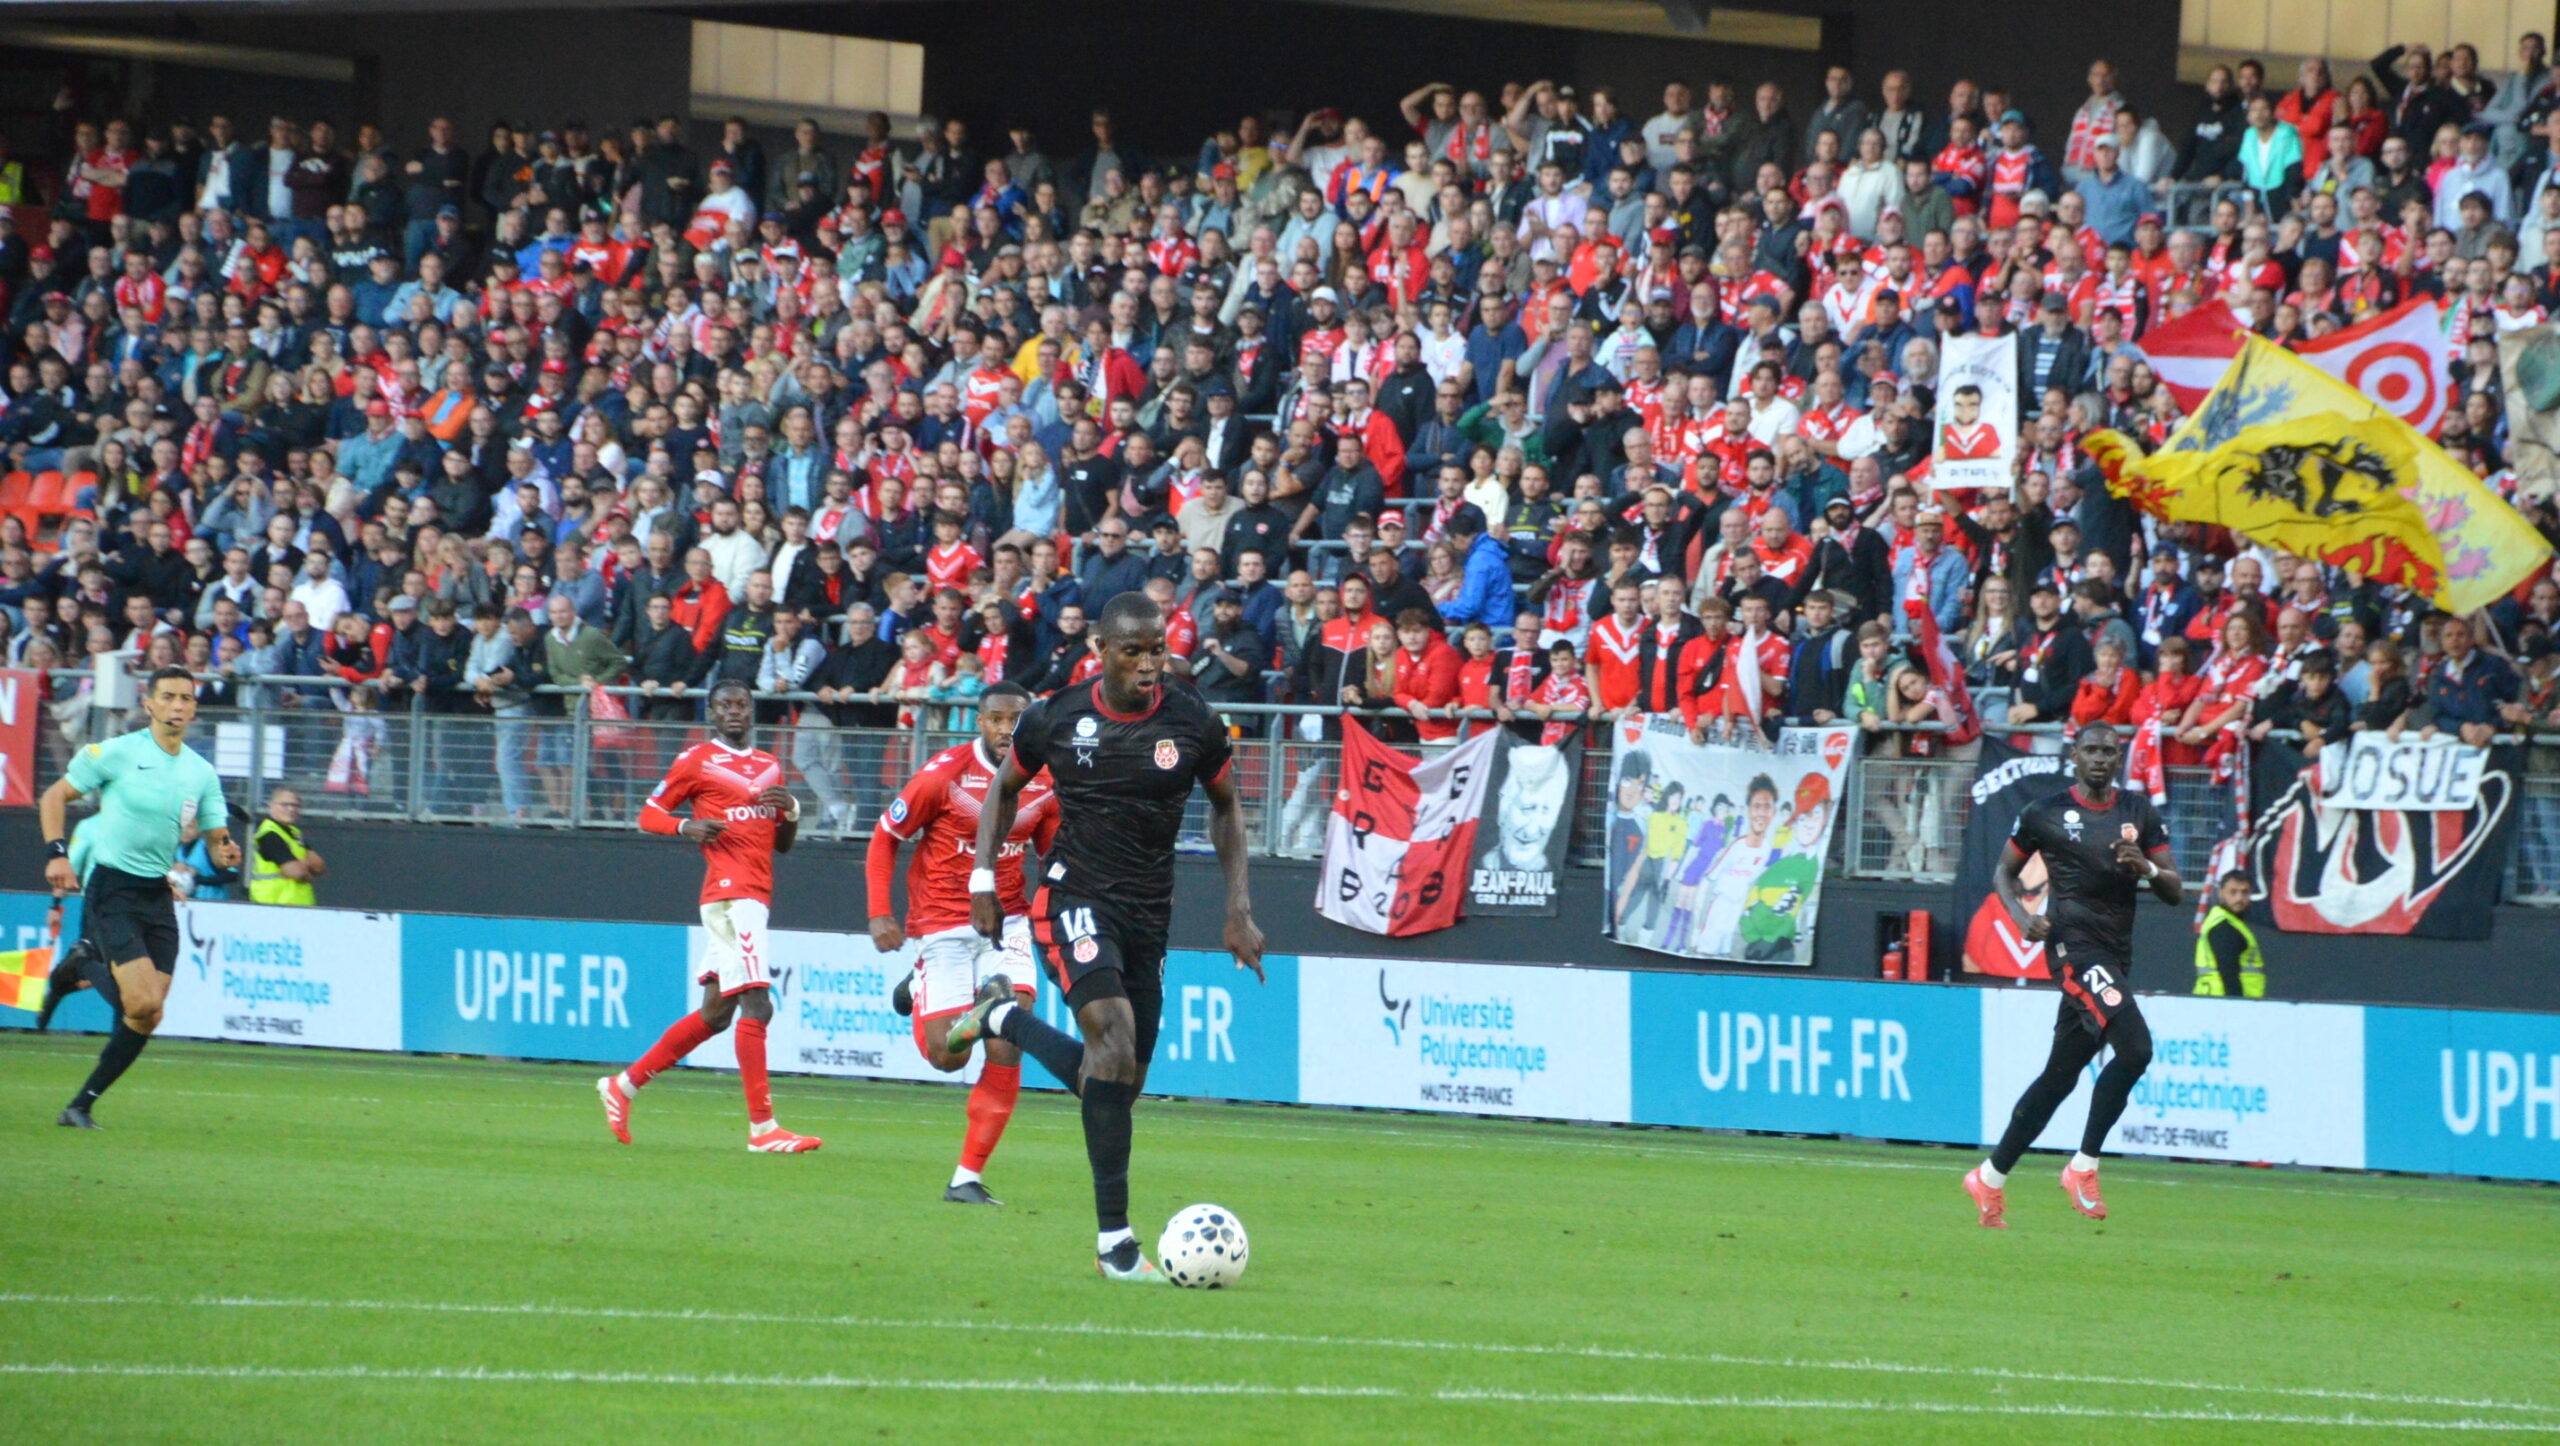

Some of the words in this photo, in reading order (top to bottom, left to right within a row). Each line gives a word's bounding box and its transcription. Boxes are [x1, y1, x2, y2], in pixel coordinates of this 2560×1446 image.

[1971, 756, 2060, 806] SECTION
[2322, 746, 2482, 803] JOSUE
[1469, 869, 1556, 895] JEAN-PAUL
[1060, 907, 1097, 943] 14
[223, 934, 304, 967] Université
[223, 969, 331, 1010] Polytechnique
[455, 949, 631, 1029] UPHF.FR
[800, 962, 885, 998] Université
[2082, 965, 2115, 995] 21
[223, 1014, 304, 1036] HAUTS-DE-FRANCE
[1421, 993, 1514, 1031] Université
[800, 1048, 884, 1069] HAUTS-DE-FRANCE
[1421, 1034, 1547, 1081] Polytechnique
[1698, 1010, 1912, 1101] UPHF.FR
[1420, 1084, 1513, 1107] HAUTS-DE-FRANCE
[2133, 1074, 2267, 1122] olytechnique
[2122, 1125, 2228, 1149] HAUTS-DE-FRANCE
